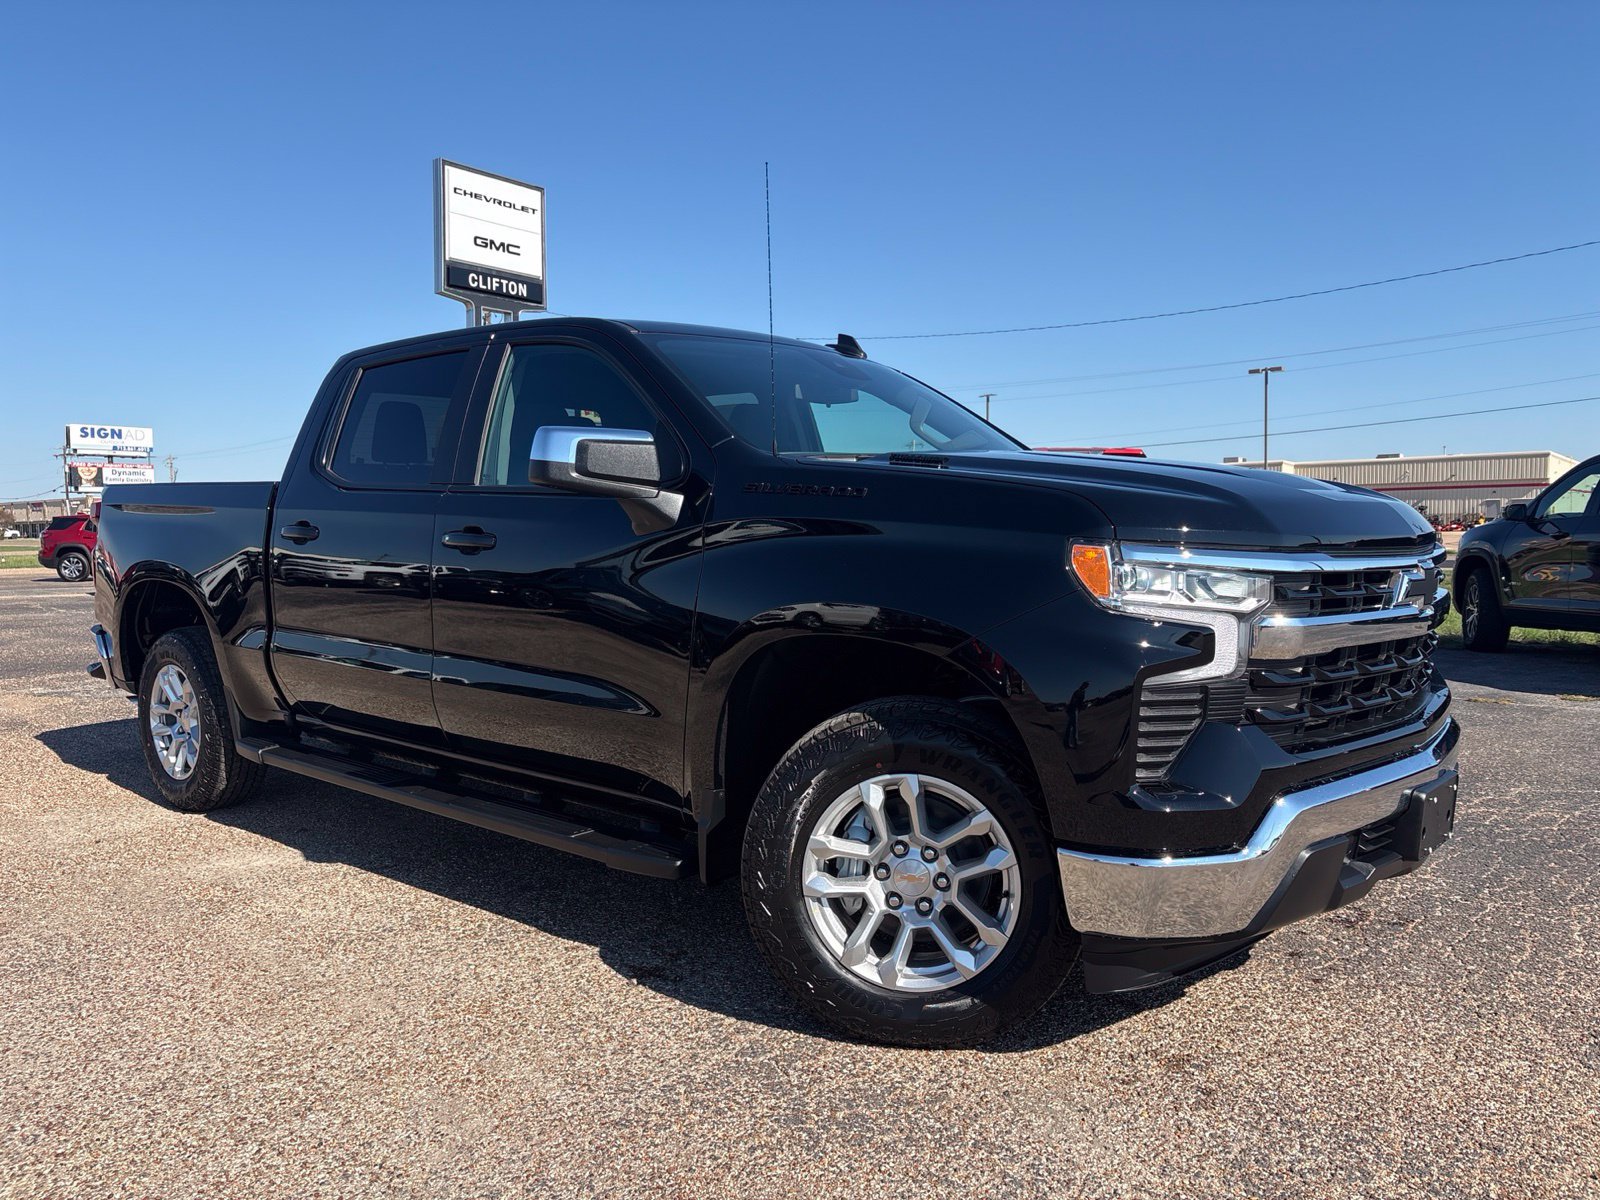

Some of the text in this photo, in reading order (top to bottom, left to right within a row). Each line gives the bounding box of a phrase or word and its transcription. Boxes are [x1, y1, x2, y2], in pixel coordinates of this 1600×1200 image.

[453, 187, 538, 215] CHEVROLET
[473, 235, 521, 256] GMC
[468, 273, 528, 297] CLIFTON
[111, 469, 146, 477] Dynamic
[743, 482, 868, 498] SILVERADO
[919, 748, 1045, 859] WRANGLER
